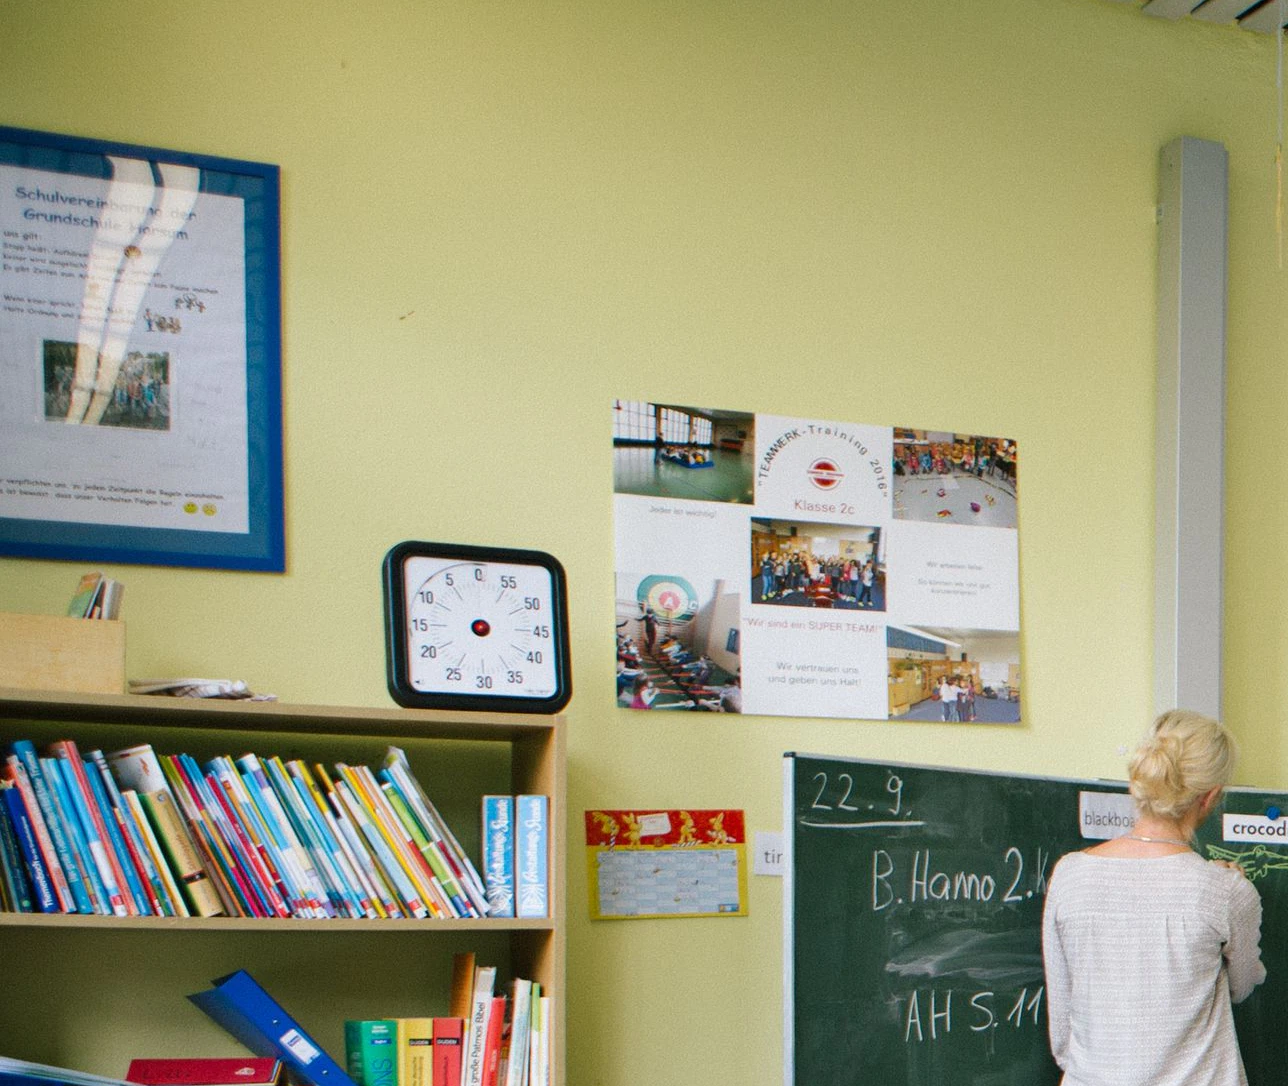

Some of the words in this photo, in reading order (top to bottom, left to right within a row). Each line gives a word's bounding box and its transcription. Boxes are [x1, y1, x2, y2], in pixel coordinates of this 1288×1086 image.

[794, 500, 836, 512] Klasse
[840, 502, 856, 514] 2c
[445, 572, 454, 587] 5
[475, 568, 483, 581] 0
[501, 576, 517, 589] 55
[419, 591, 434, 604] 10
[524, 597, 540, 610] 50
[412, 619, 428, 632] 15
[533, 625, 549, 639] 45
[767, 620, 787, 629] sind
[808, 620, 843, 632] SUPER
[421, 645, 437, 659] 20
[526, 651, 542, 664] 40
[446, 667, 462, 681] 25
[777, 661, 793, 671] Wir
[795, 663, 839, 674] vertrauen
[842, 666, 860, 674] uns
[476, 675, 493, 689] 30
[507, 670, 523, 684] 35
[768, 675, 786, 684] und
[788, 675, 818, 686] geben
[476, 1001, 486, 1024] Bibel
[472, 1025, 483, 1058] Patmos
[470, 1058, 481, 1086] große
